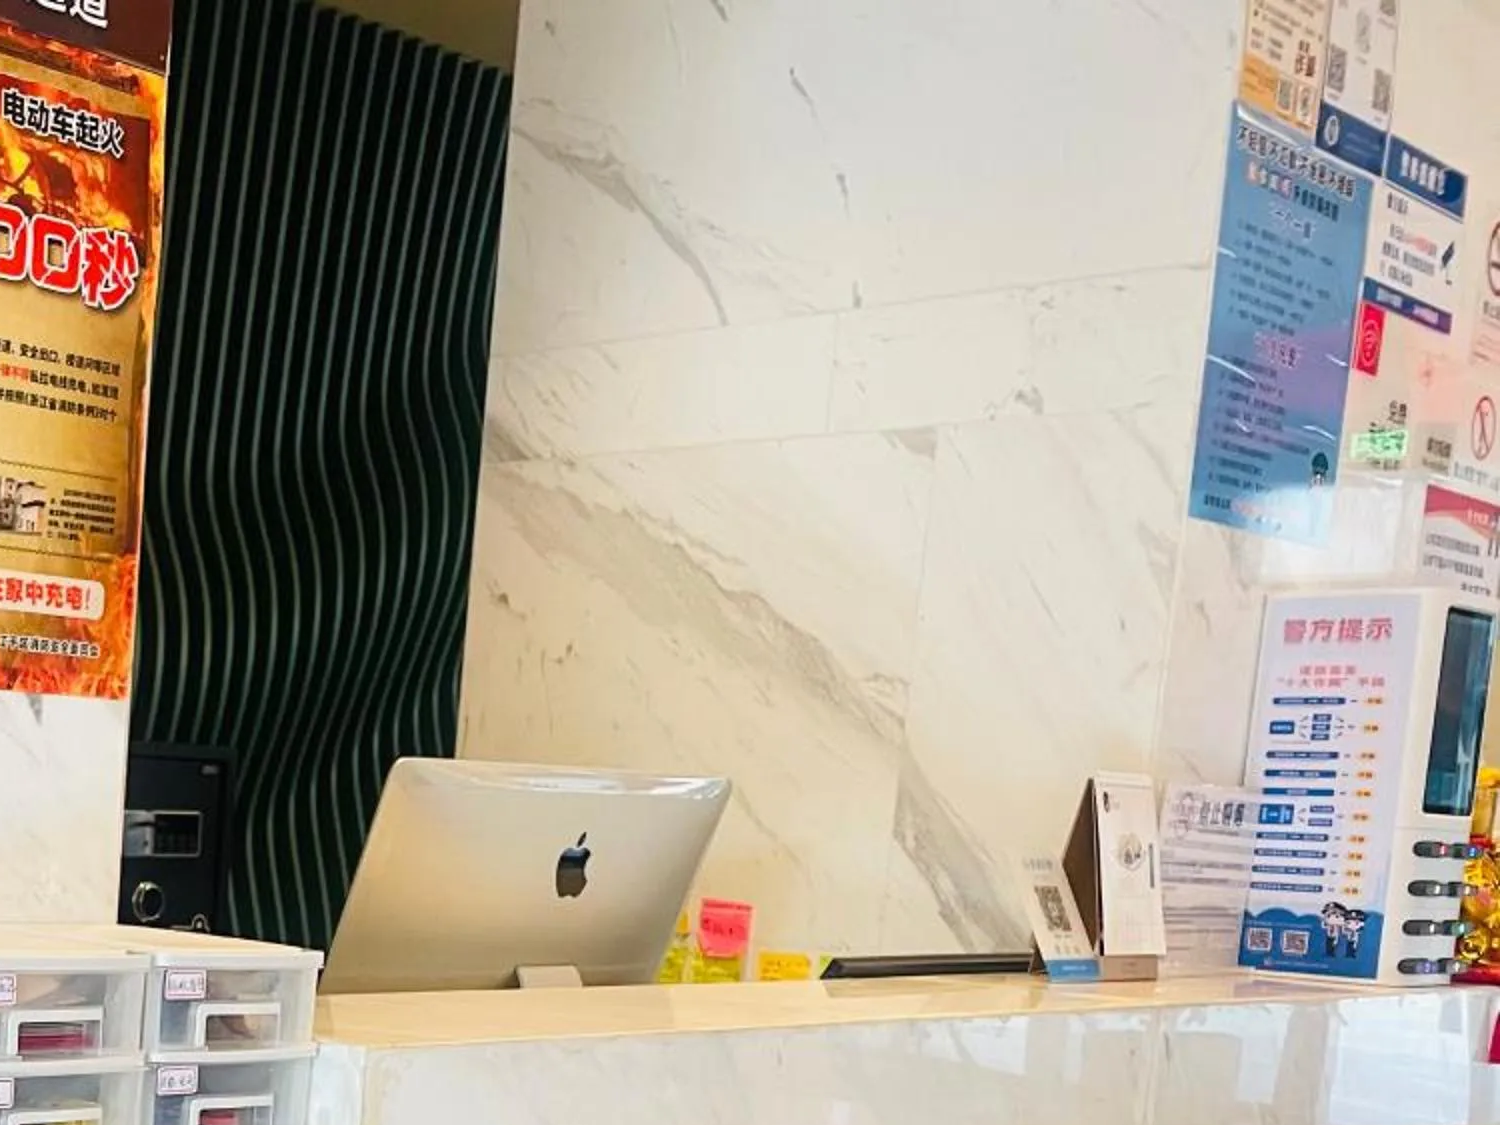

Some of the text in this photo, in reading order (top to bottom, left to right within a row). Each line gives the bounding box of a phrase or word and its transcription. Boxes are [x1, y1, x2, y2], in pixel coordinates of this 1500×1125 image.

[2, 90, 125, 157] 电动车起火
